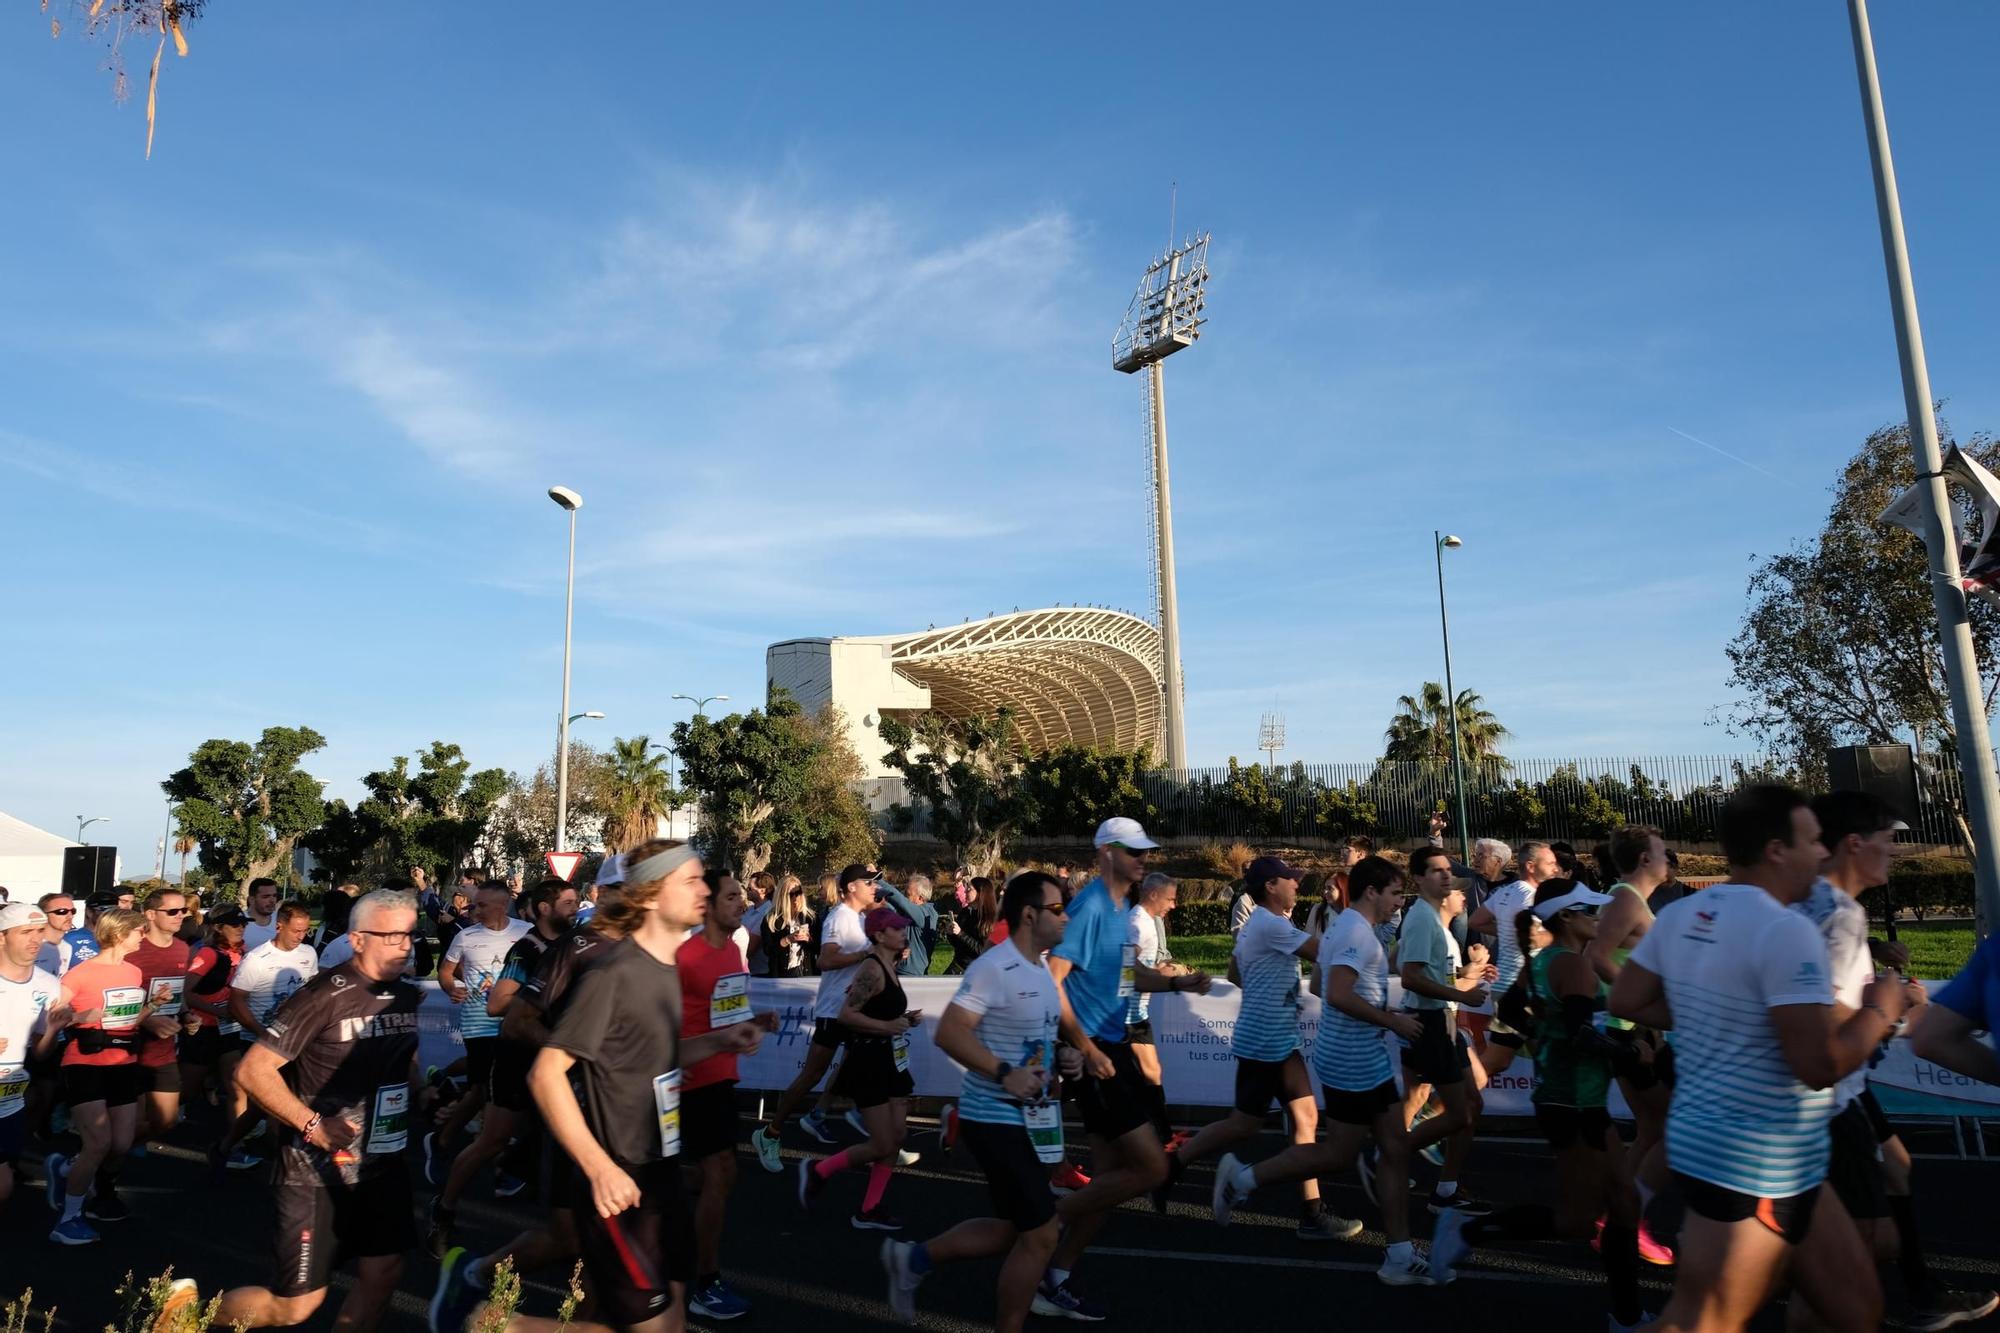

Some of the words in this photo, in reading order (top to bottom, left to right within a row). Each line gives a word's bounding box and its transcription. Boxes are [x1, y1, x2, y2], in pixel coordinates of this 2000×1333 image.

[1198, 1017, 1236, 1030] Somo
[1160, 1031, 1235, 1046] multiene
[1189, 1051, 1209, 1062] tus
